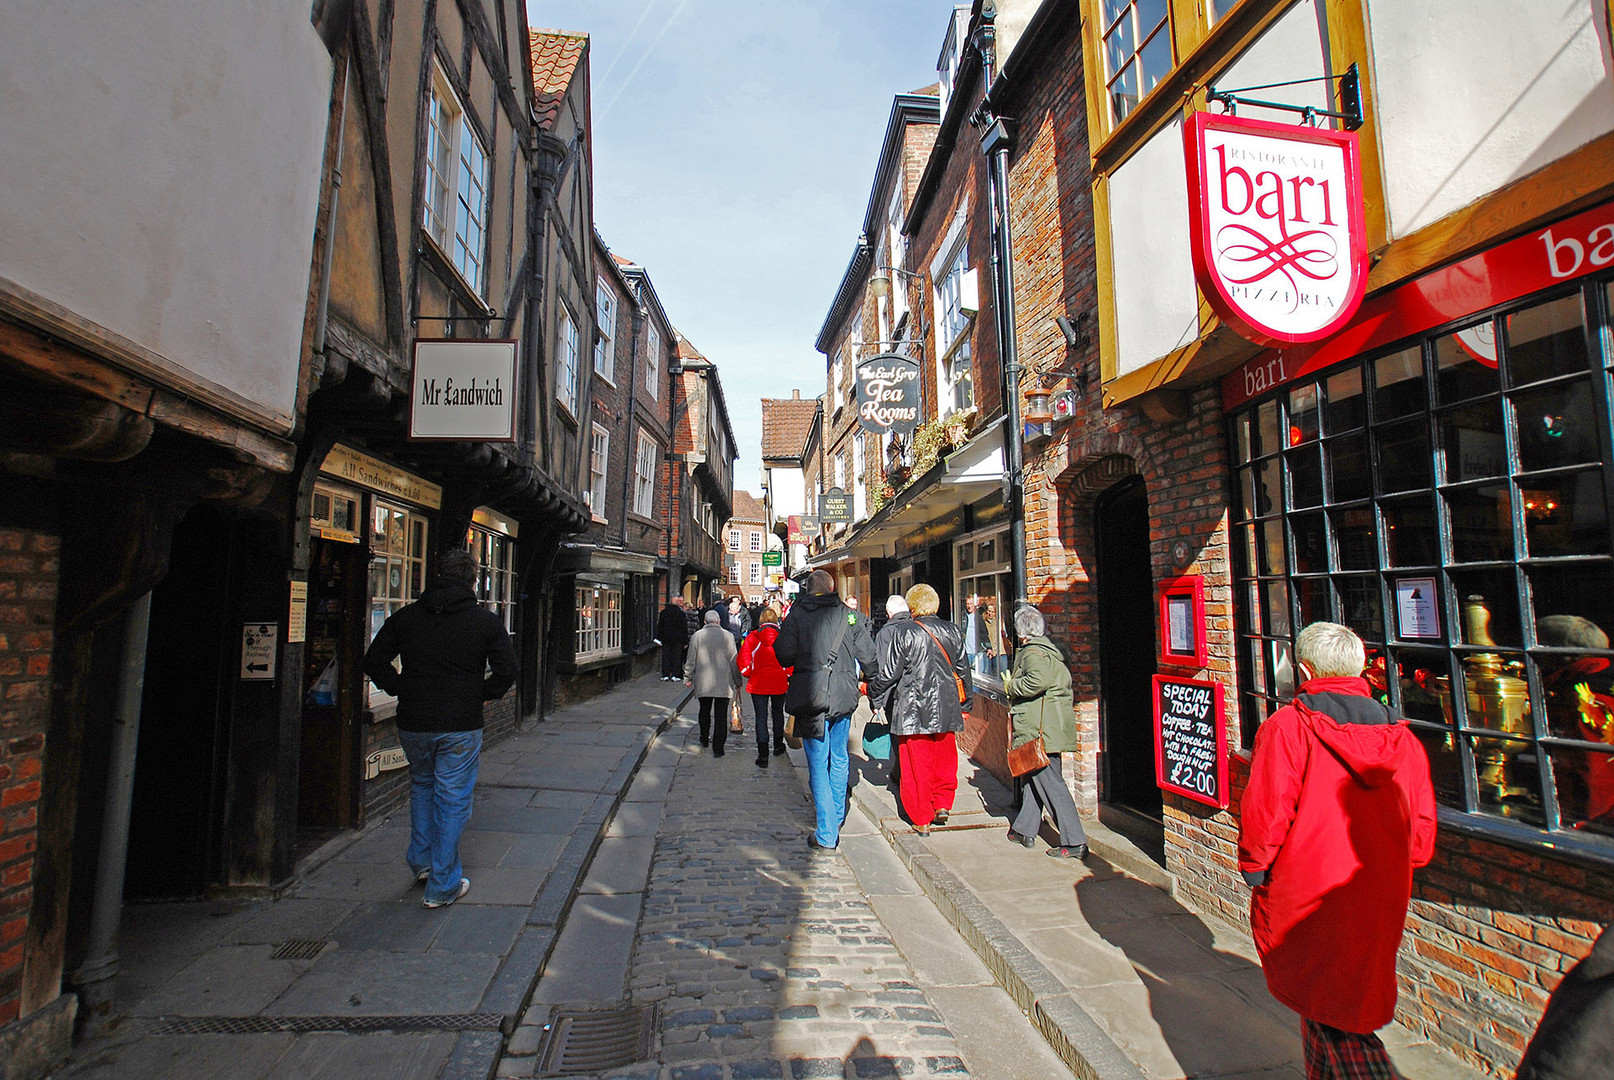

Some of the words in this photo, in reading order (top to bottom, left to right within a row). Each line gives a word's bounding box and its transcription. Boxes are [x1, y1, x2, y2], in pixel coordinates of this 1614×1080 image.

[1212, 144, 1338, 227] bari
[1232, 286, 1334, 307] PIZZERIA
[875, 366, 895, 379] Earl
[1243, 349, 1287, 396] bari
[422, 379, 441, 406] Mr
[866, 379, 904, 402] Tea
[861, 401, 917, 426] Rooms
[342, 461, 356, 478] All
[359, 467, 402, 493] Sandwiches
[1163, 684, 1212, 704] SPECIAL
[1171, 700, 1209, 719] TODAY
[1162, 728, 1175, 740] HOT
[1175, 732, 1216, 751] CHOCOLATE
[1195, 721, 1214, 738] TEA
[382, 755, 391, 765] All
[1189, 746, 1216, 762] FRESH
